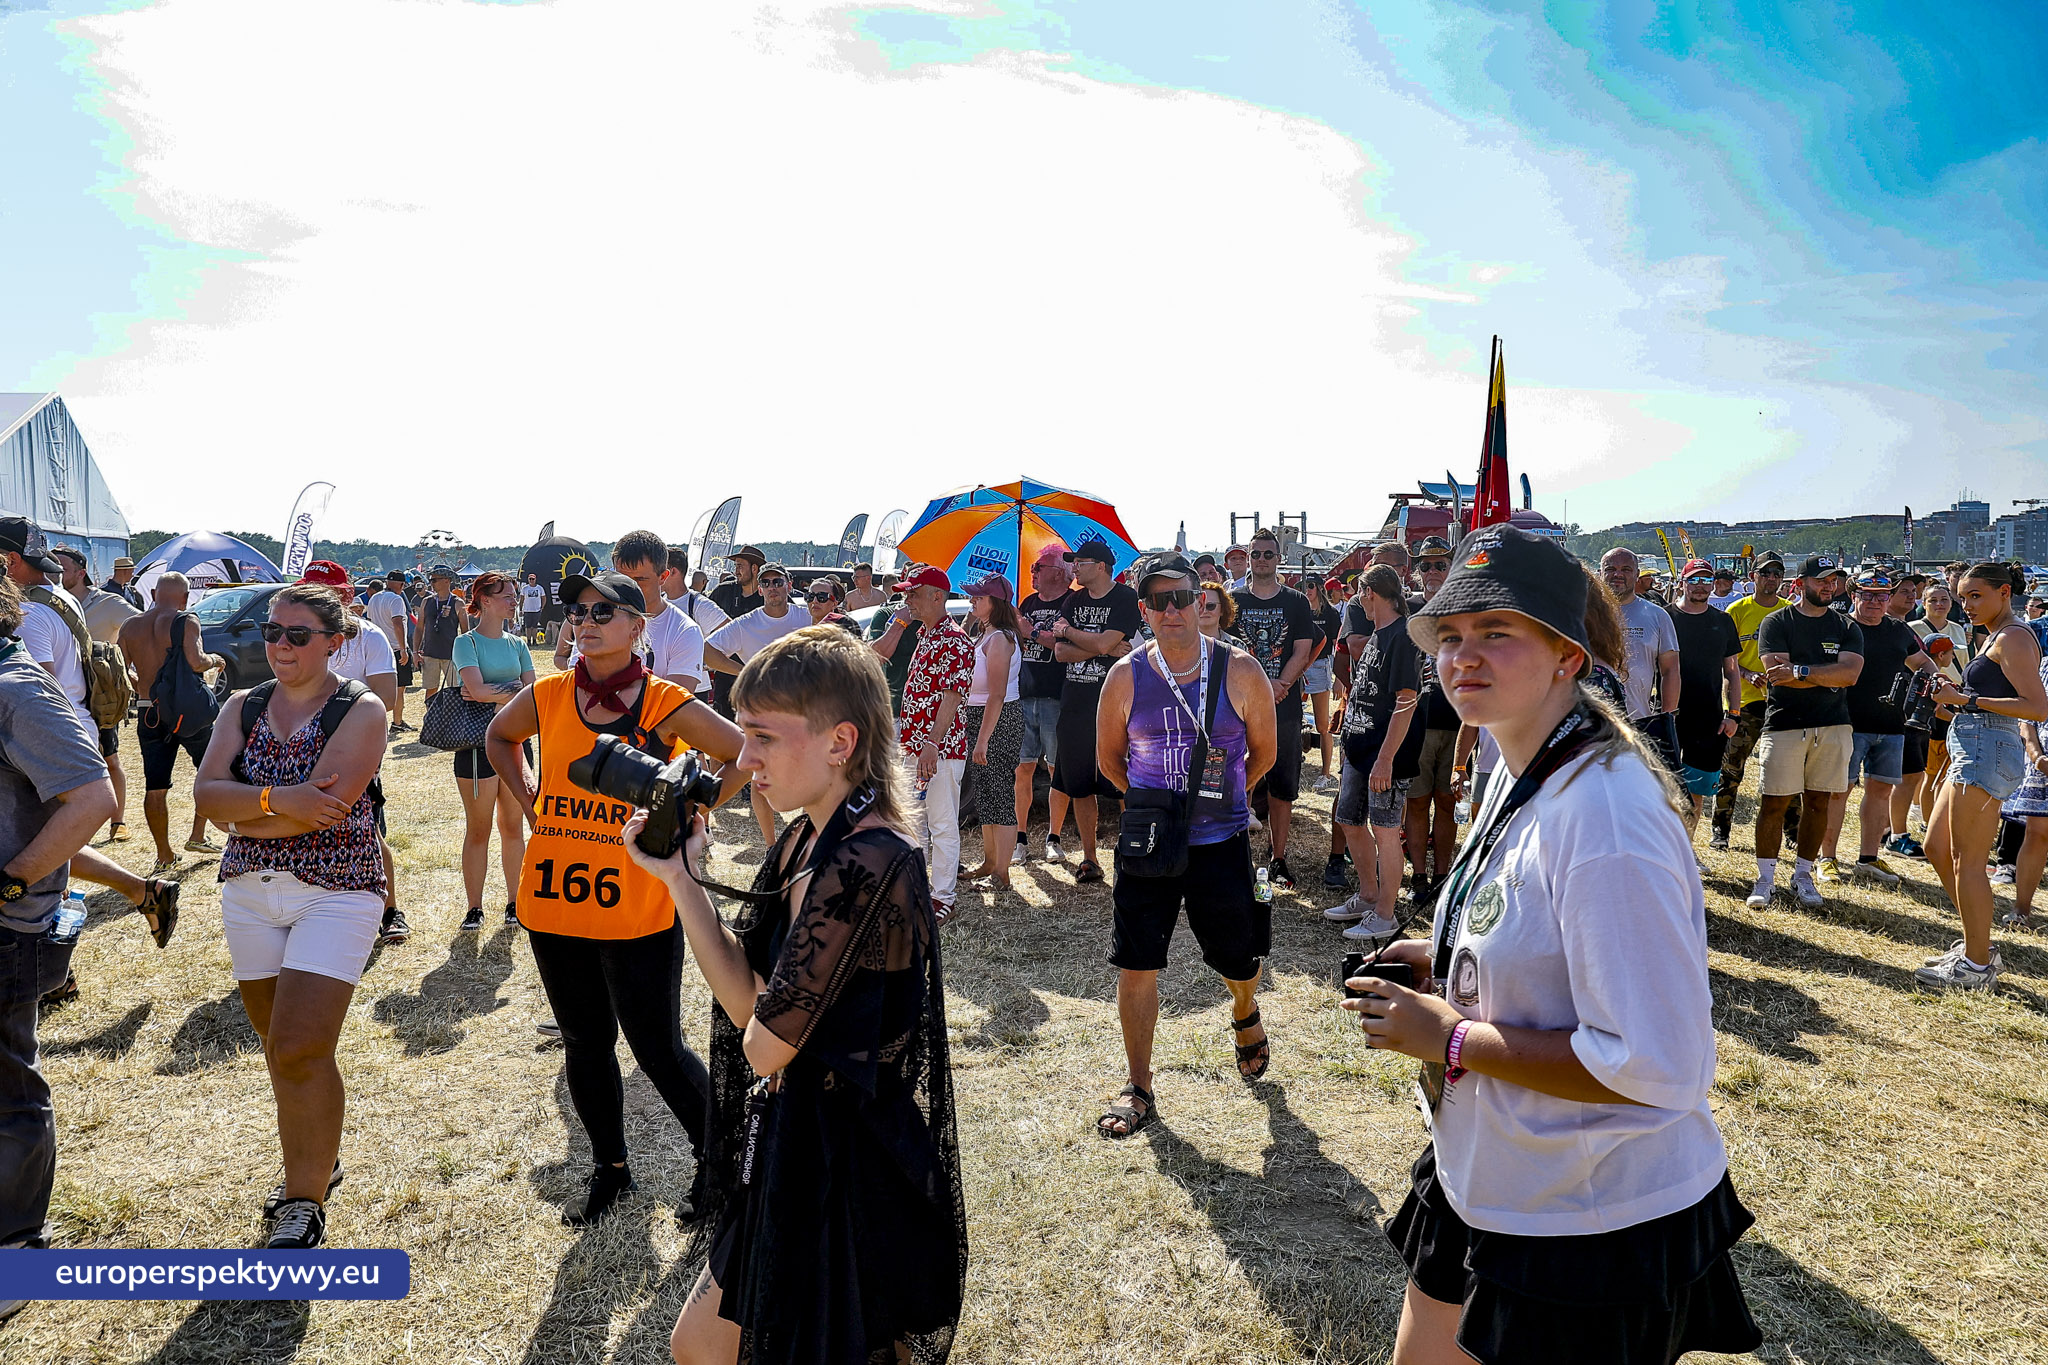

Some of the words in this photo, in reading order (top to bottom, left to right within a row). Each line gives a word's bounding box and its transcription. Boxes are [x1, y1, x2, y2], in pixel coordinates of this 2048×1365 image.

[306, 565, 330, 574] MOTUL
[1548, 713, 1582, 749] metabo
[543, 795, 629, 826] TEWAR
[534, 824, 563, 838] UŻBA
[565, 828, 625, 847] PORZĄDKO
[533, 858, 621, 909] 166
[1446, 904, 1463, 949] metabo
